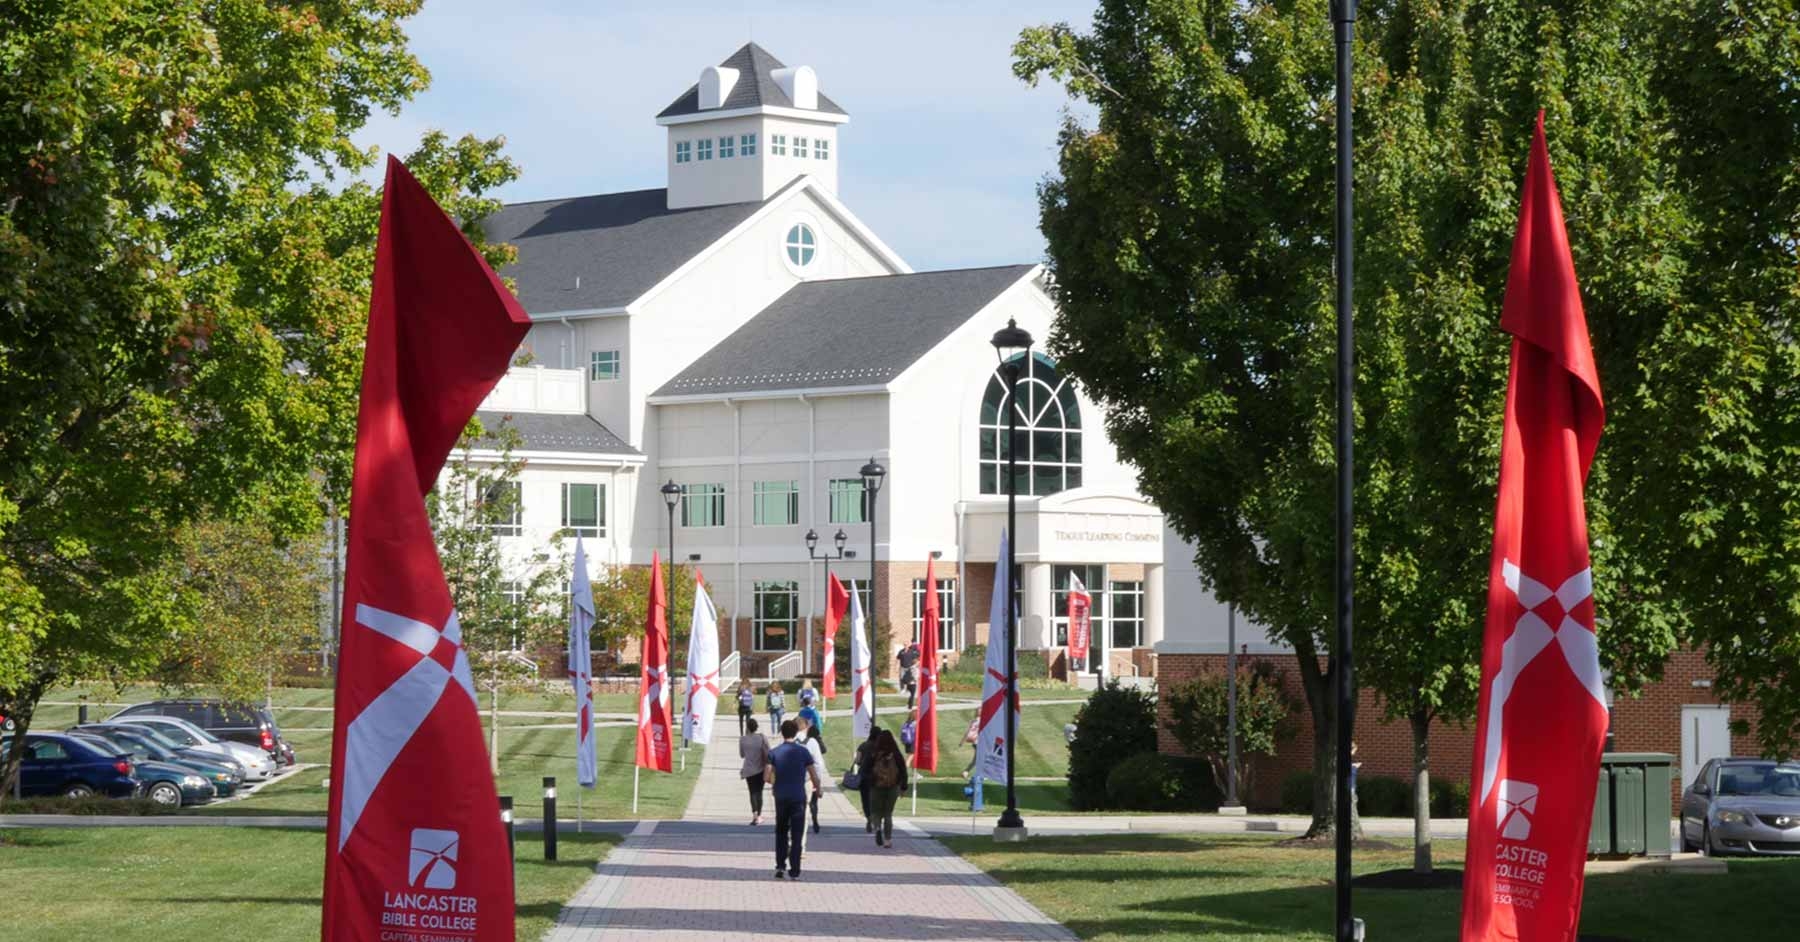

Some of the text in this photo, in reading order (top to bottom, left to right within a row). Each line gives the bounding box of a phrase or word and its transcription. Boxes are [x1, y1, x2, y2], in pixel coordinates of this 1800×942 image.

[1496, 863, 1545, 885] COLLEGE
[384, 891, 477, 913] LANCASTER
[382, 911, 477, 930] BIBLE COLLEGE
